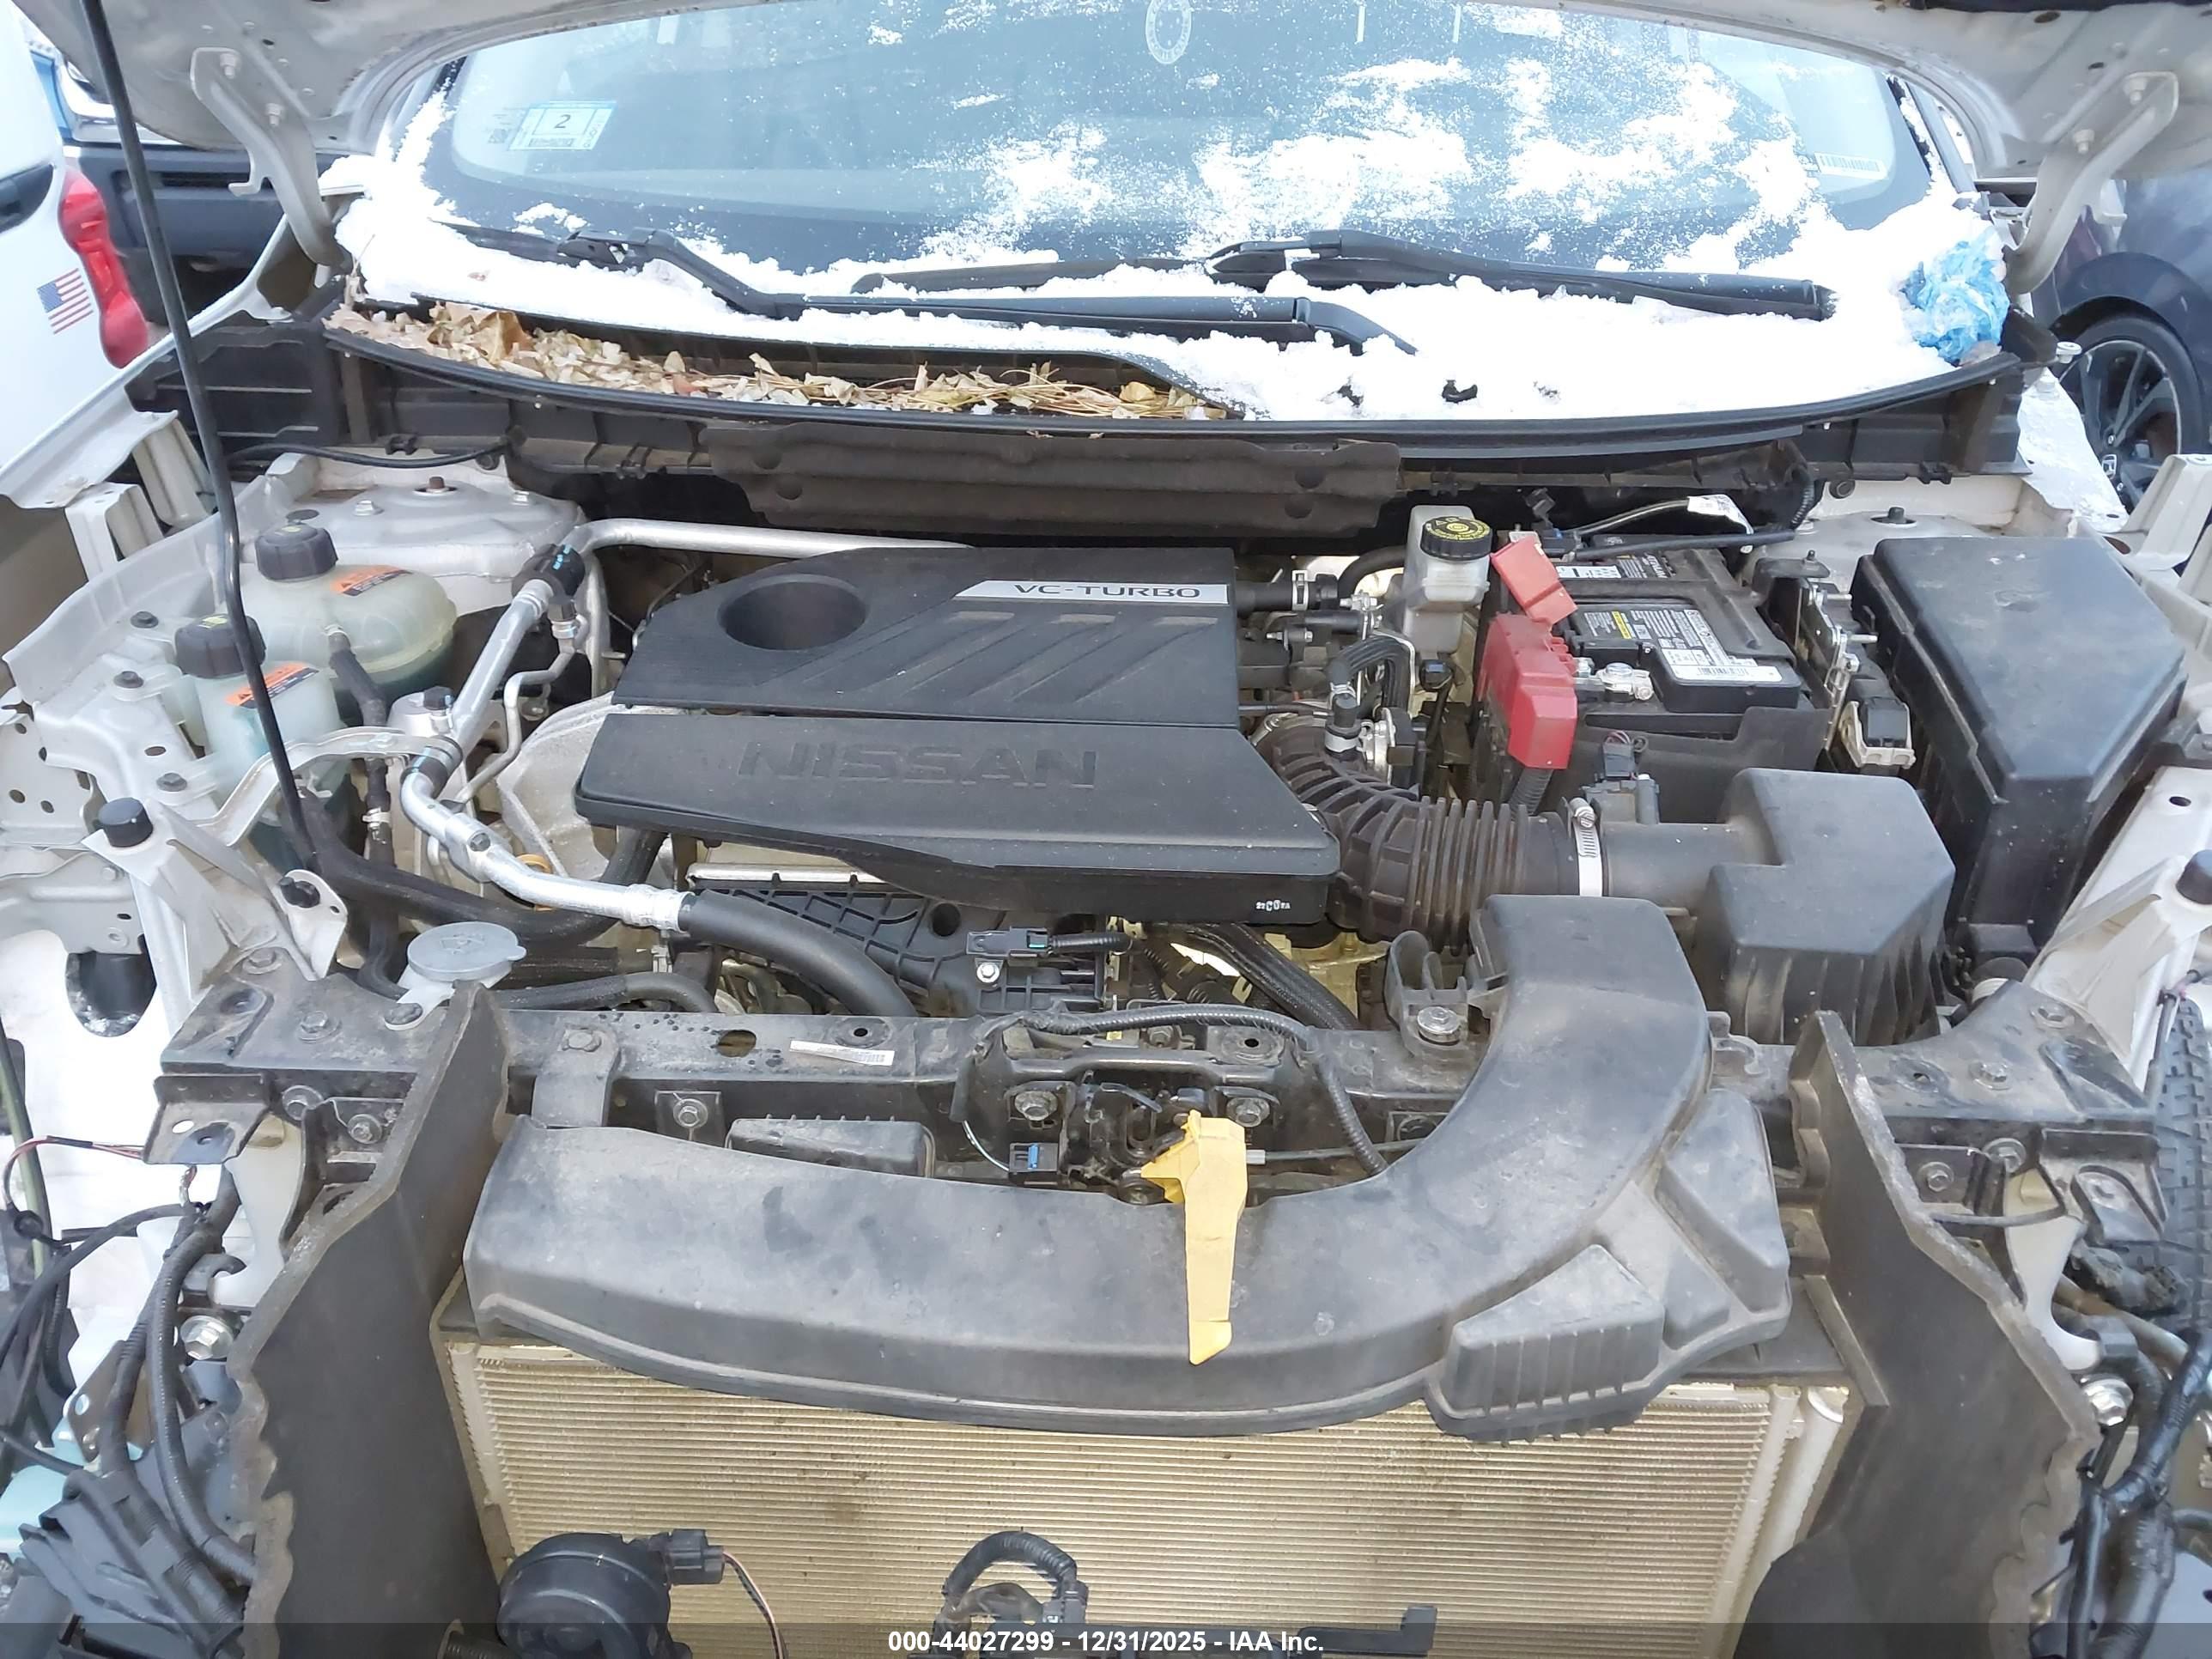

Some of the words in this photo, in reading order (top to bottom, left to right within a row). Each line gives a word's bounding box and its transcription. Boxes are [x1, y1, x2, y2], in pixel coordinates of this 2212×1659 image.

[554, 113, 572, 129] 2
[1013, 584, 1201, 599] VC-TURBO
[737, 740, 1098, 788] NISSAN
